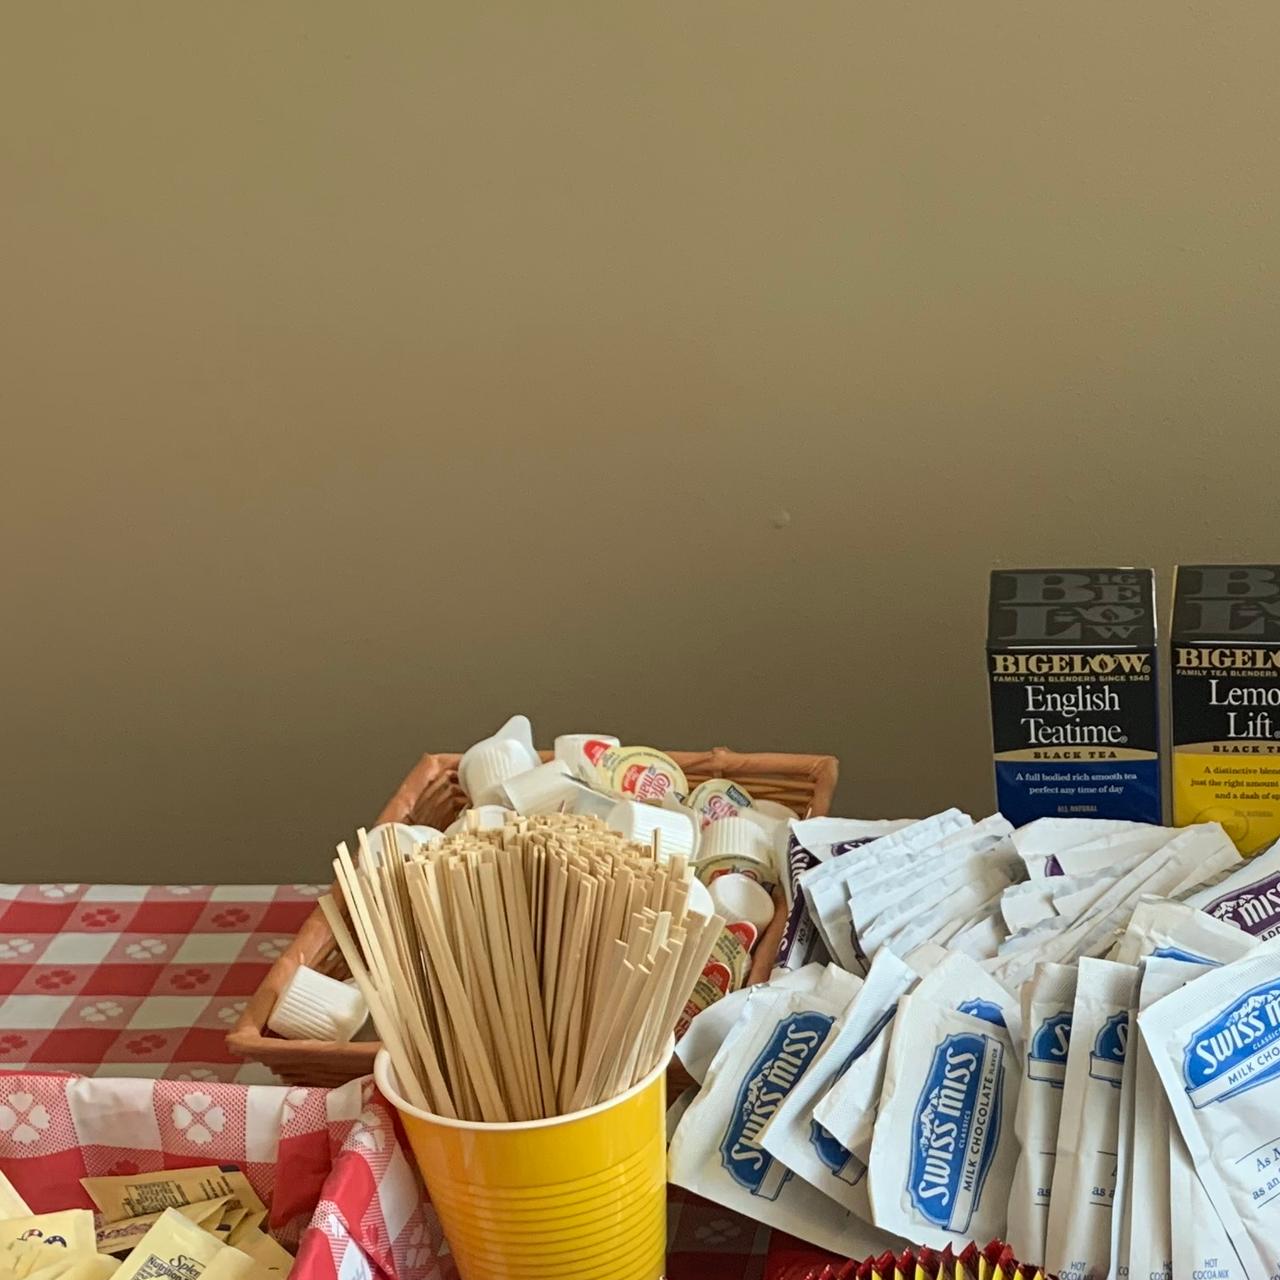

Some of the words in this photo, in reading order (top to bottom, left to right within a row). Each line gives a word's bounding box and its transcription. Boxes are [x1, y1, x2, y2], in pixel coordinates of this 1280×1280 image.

[992, 654, 1149, 674] BIGELOW
[1026, 685, 1120, 717] English
[1021, 718, 1121, 744] Teatime
[1227, 712, 1272, 738] Lift
[1016, 773, 1023, 781] A
[1026, 773, 1040, 781] full
[1042, 773, 1070, 781] bodied
[1073, 773, 1089, 781] rich
[1029, 786, 1058, 794] perfect
[1109, 785, 1124, 793] day
[1196, 1010, 1265, 1075] SWISS
[990, 1047, 999, 1076] FLAVOR
[1228, 1063, 1254, 1085] MILK
[920, 1120, 956, 1206] SWISS
[941, 1046, 976, 1115] MISS
[969, 1075, 993, 1160] CHOCOLATE
[958, 1111, 972, 1149] CLASSICS
[1256, 1158, 1271, 1172] As
[964, 1163, 978, 1192] MILK
[1252, 1188, 1265, 1200] as
[1267, 1177, 1279, 1191] an
[1058, 1270, 1083, 1280] COCOA
[1071, 1262, 1086, 1271] HOT
[1193, 1271, 1217, 1280] COCOA
[1217, 1271, 1229, 1279] MIX
[1204, 1259, 1217, 1269] HOT
